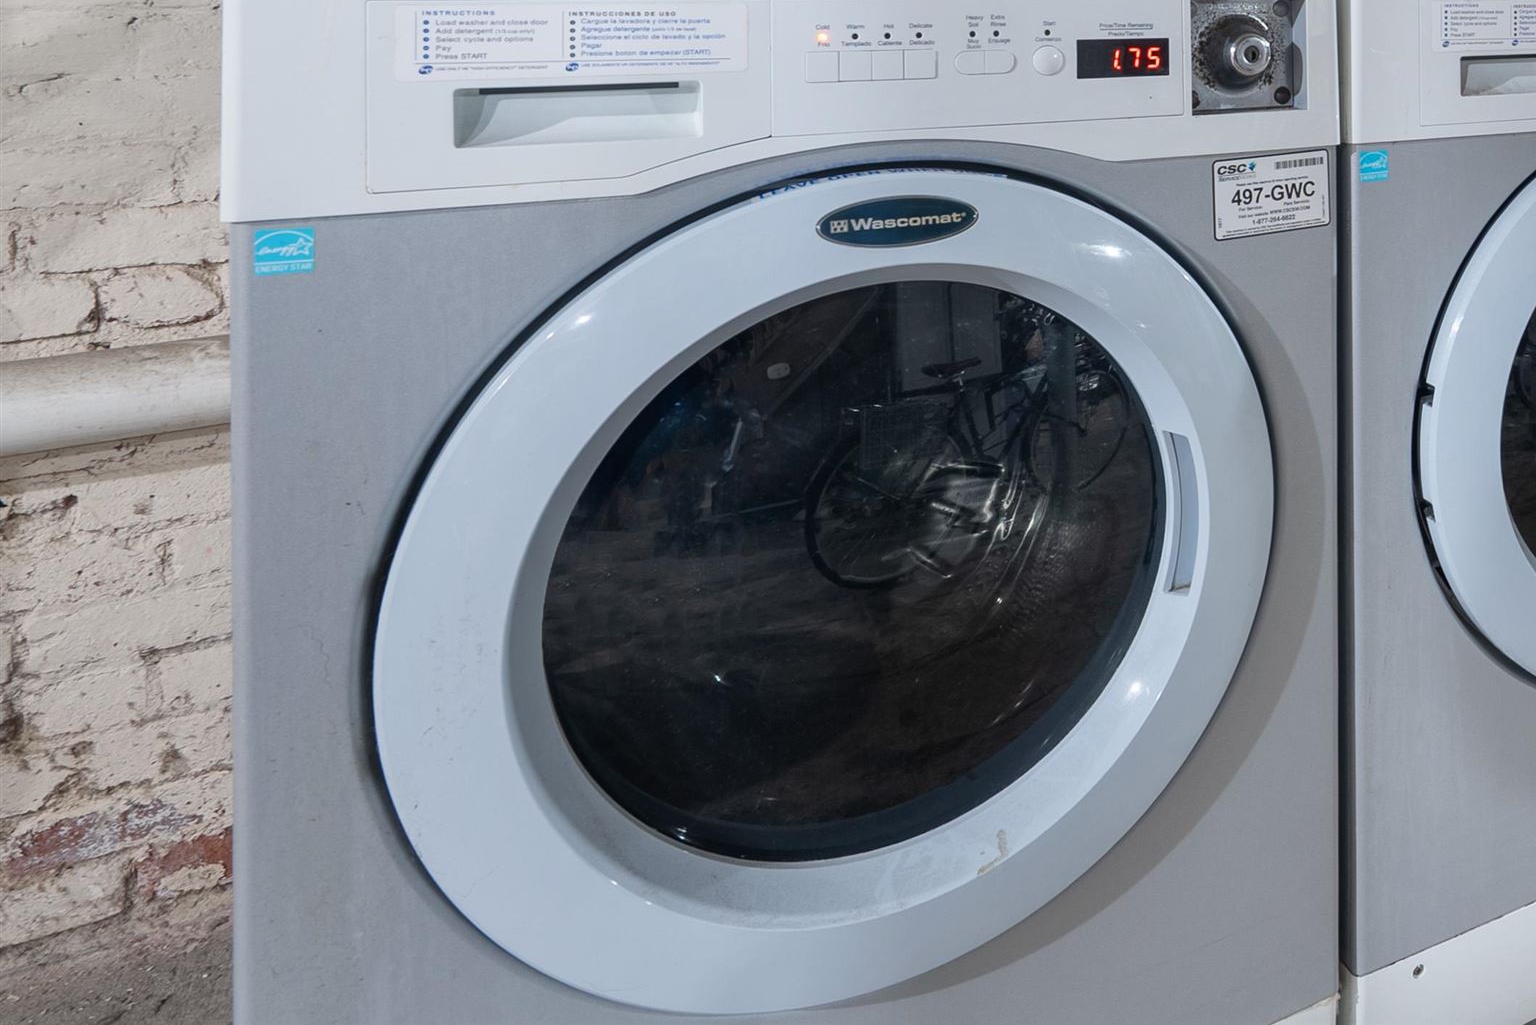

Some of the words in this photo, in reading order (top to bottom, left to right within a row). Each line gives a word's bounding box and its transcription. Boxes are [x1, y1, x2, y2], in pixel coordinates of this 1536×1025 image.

[1217, 163, 1247, 176] CSC
[1231, 181, 1316, 206] 497-GWC
[850, 211, 963, 232] Wascomat
[255, 264, 290, 274] ENERGY
[290, 262, 313, 272] STAR
